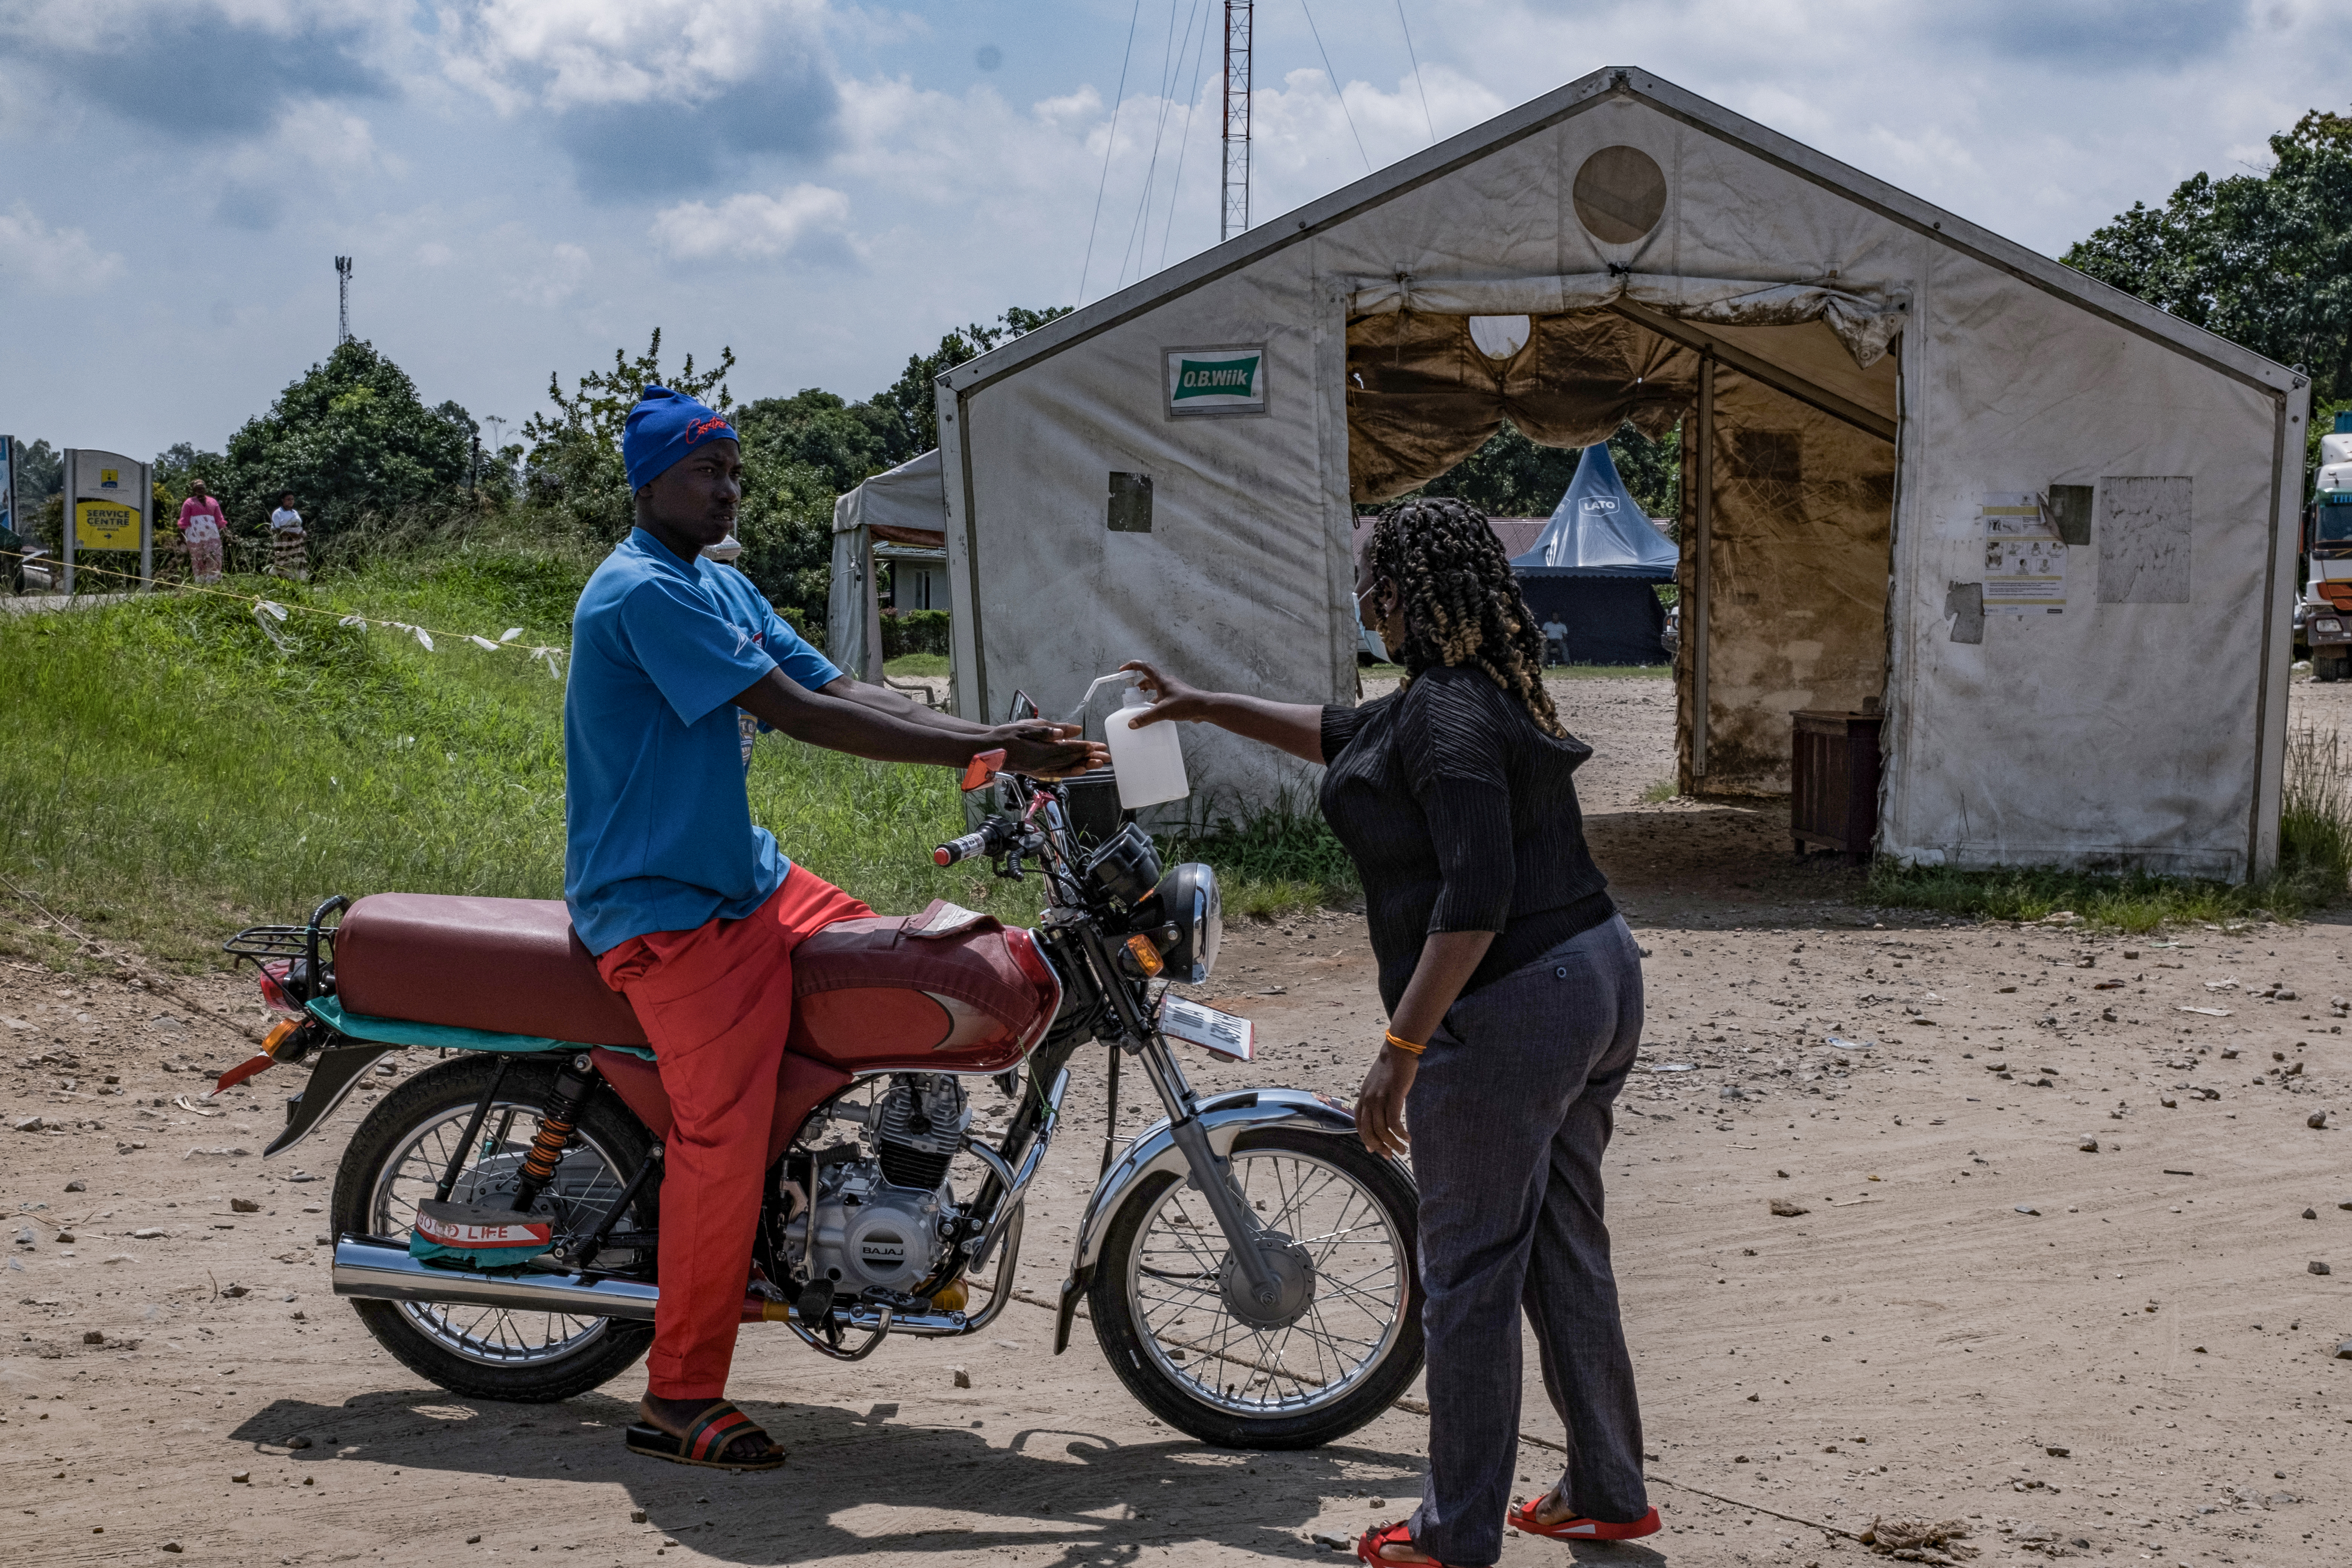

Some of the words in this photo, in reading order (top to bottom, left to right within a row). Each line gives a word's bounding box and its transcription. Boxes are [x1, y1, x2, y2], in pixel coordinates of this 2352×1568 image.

[1183, 369, 1248, 387] O.B.Wiik
[1584, 501, 1615, 510] LATO
[87, 510, 130, 518] SERVICE
[87, 517, 129, 525] CENTRE
[1172, 1006, 1204, 1028] UMA
[1210, 1012, 1242, 1044] 439KH
[467, 1226, 508, 1239] LIFE
[863, 1247, 904, 1256] BAJAJ
